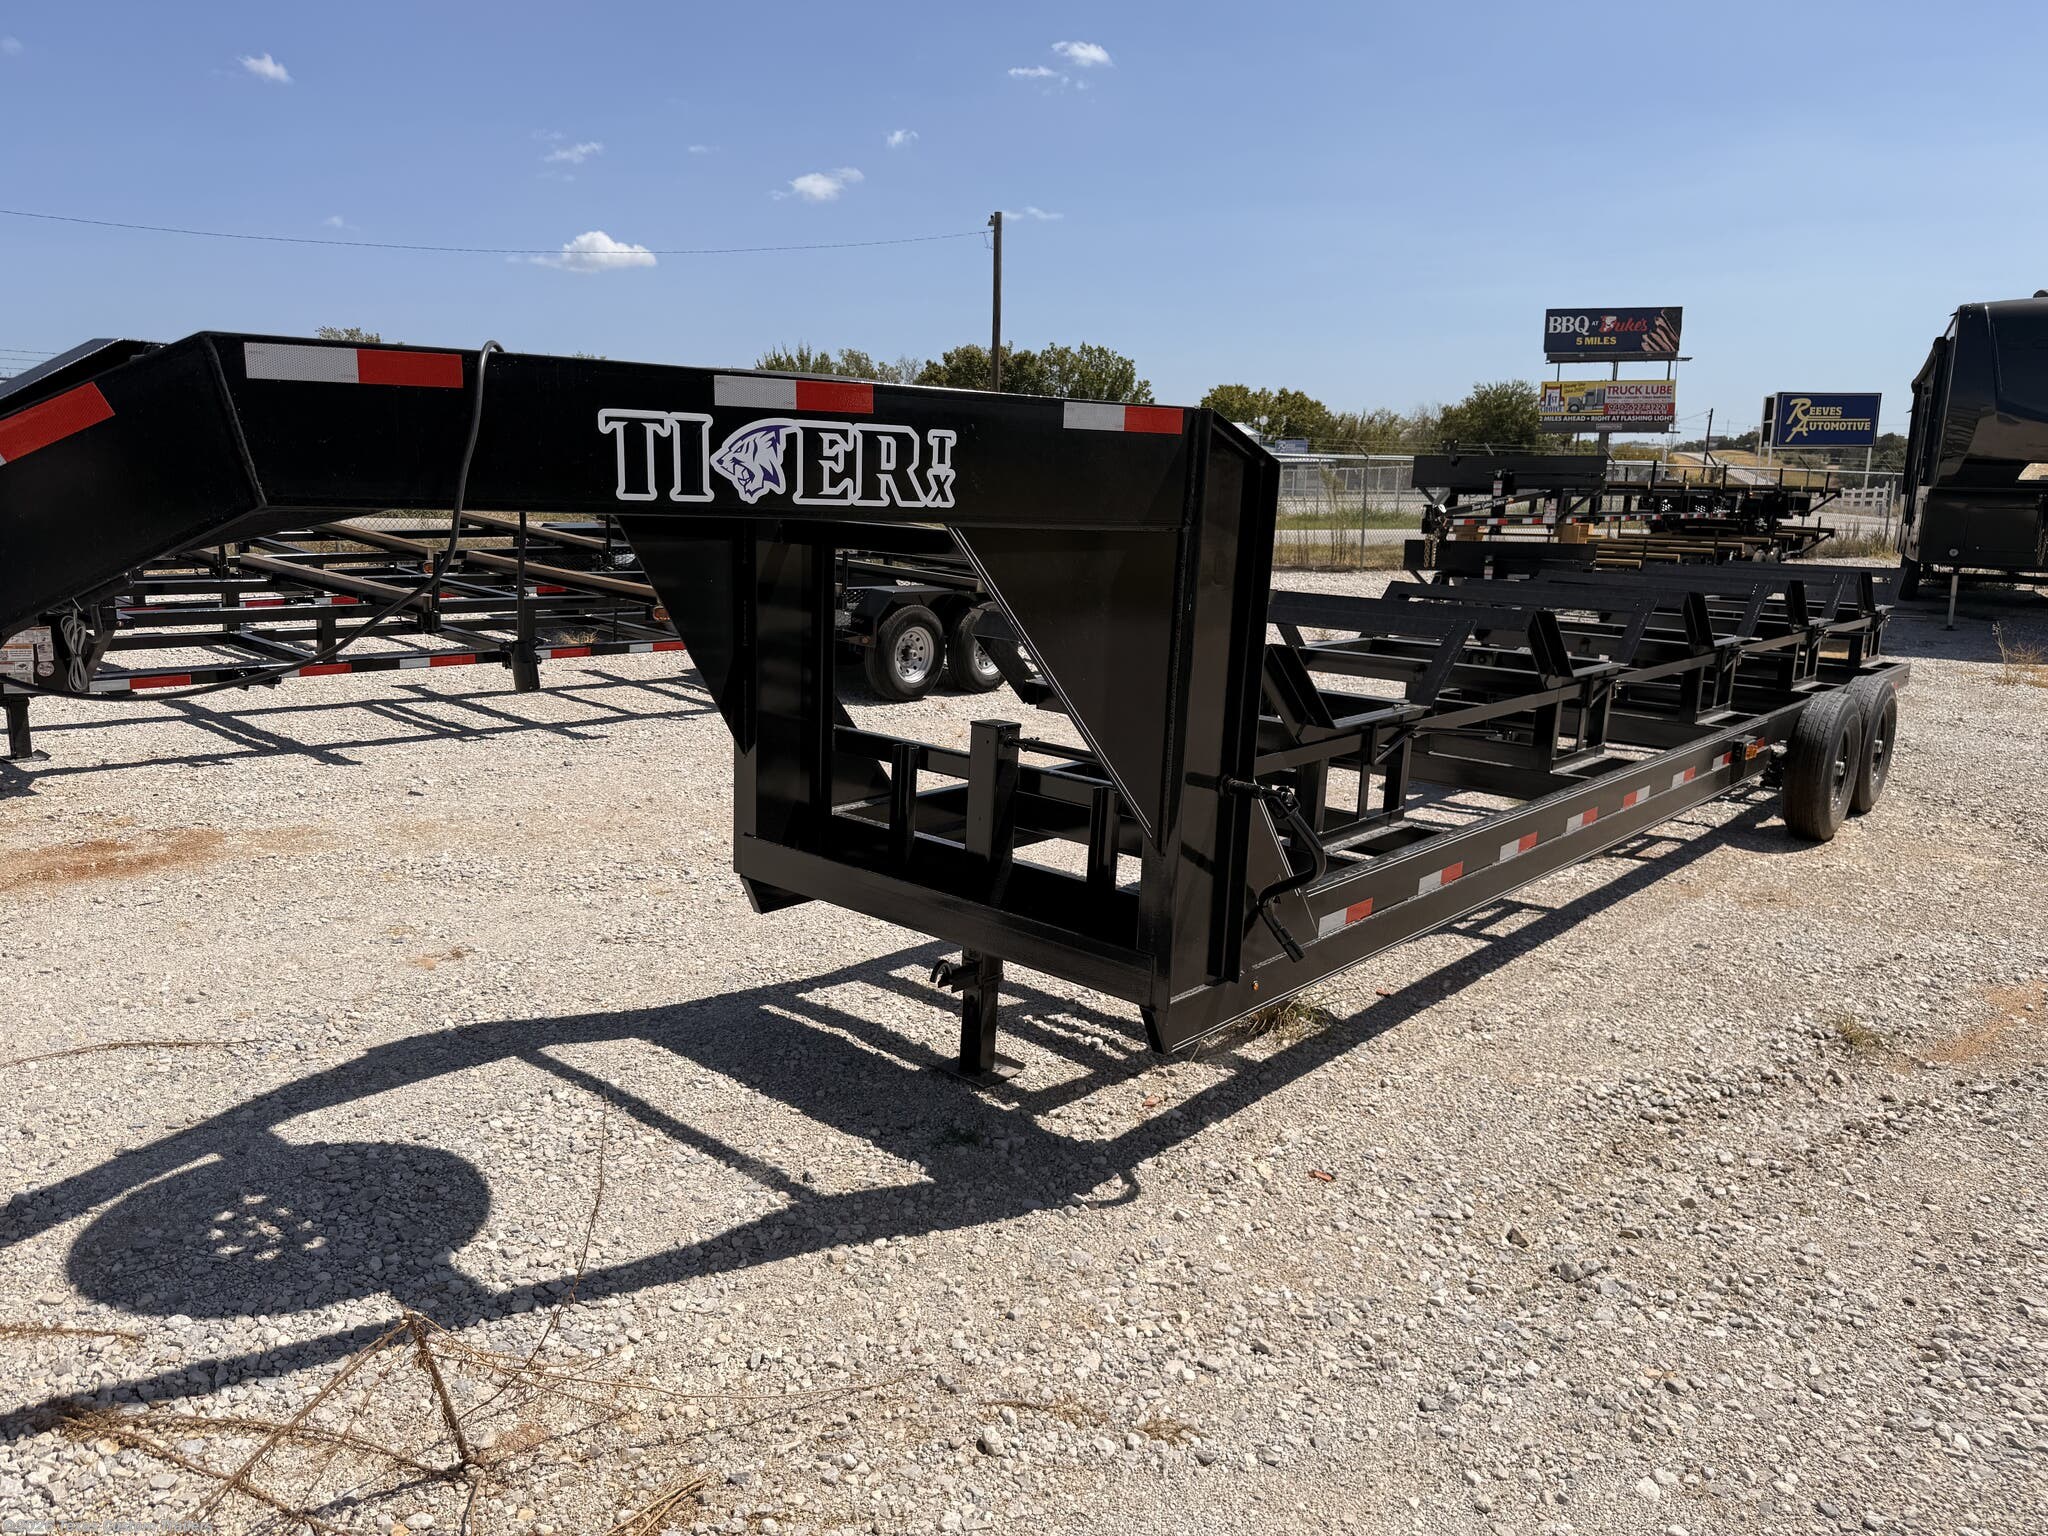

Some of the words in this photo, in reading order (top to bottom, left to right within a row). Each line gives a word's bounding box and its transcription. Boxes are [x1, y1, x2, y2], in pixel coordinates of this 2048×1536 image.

[1548, 315, 1590, 335] BBQ
[1575, 337, 1583, 345] 5
[1584, 336, 1617, 345] MILES
[1607, 385, 1643, 395] TRUCK
[1645, 385, 1673, 395] LUBE
[1786, 398, 1843, 425] REEVES
[1785, 415, 1871, 442] AUTOMOTIVE
[598, 408, 924, 507] TIER
